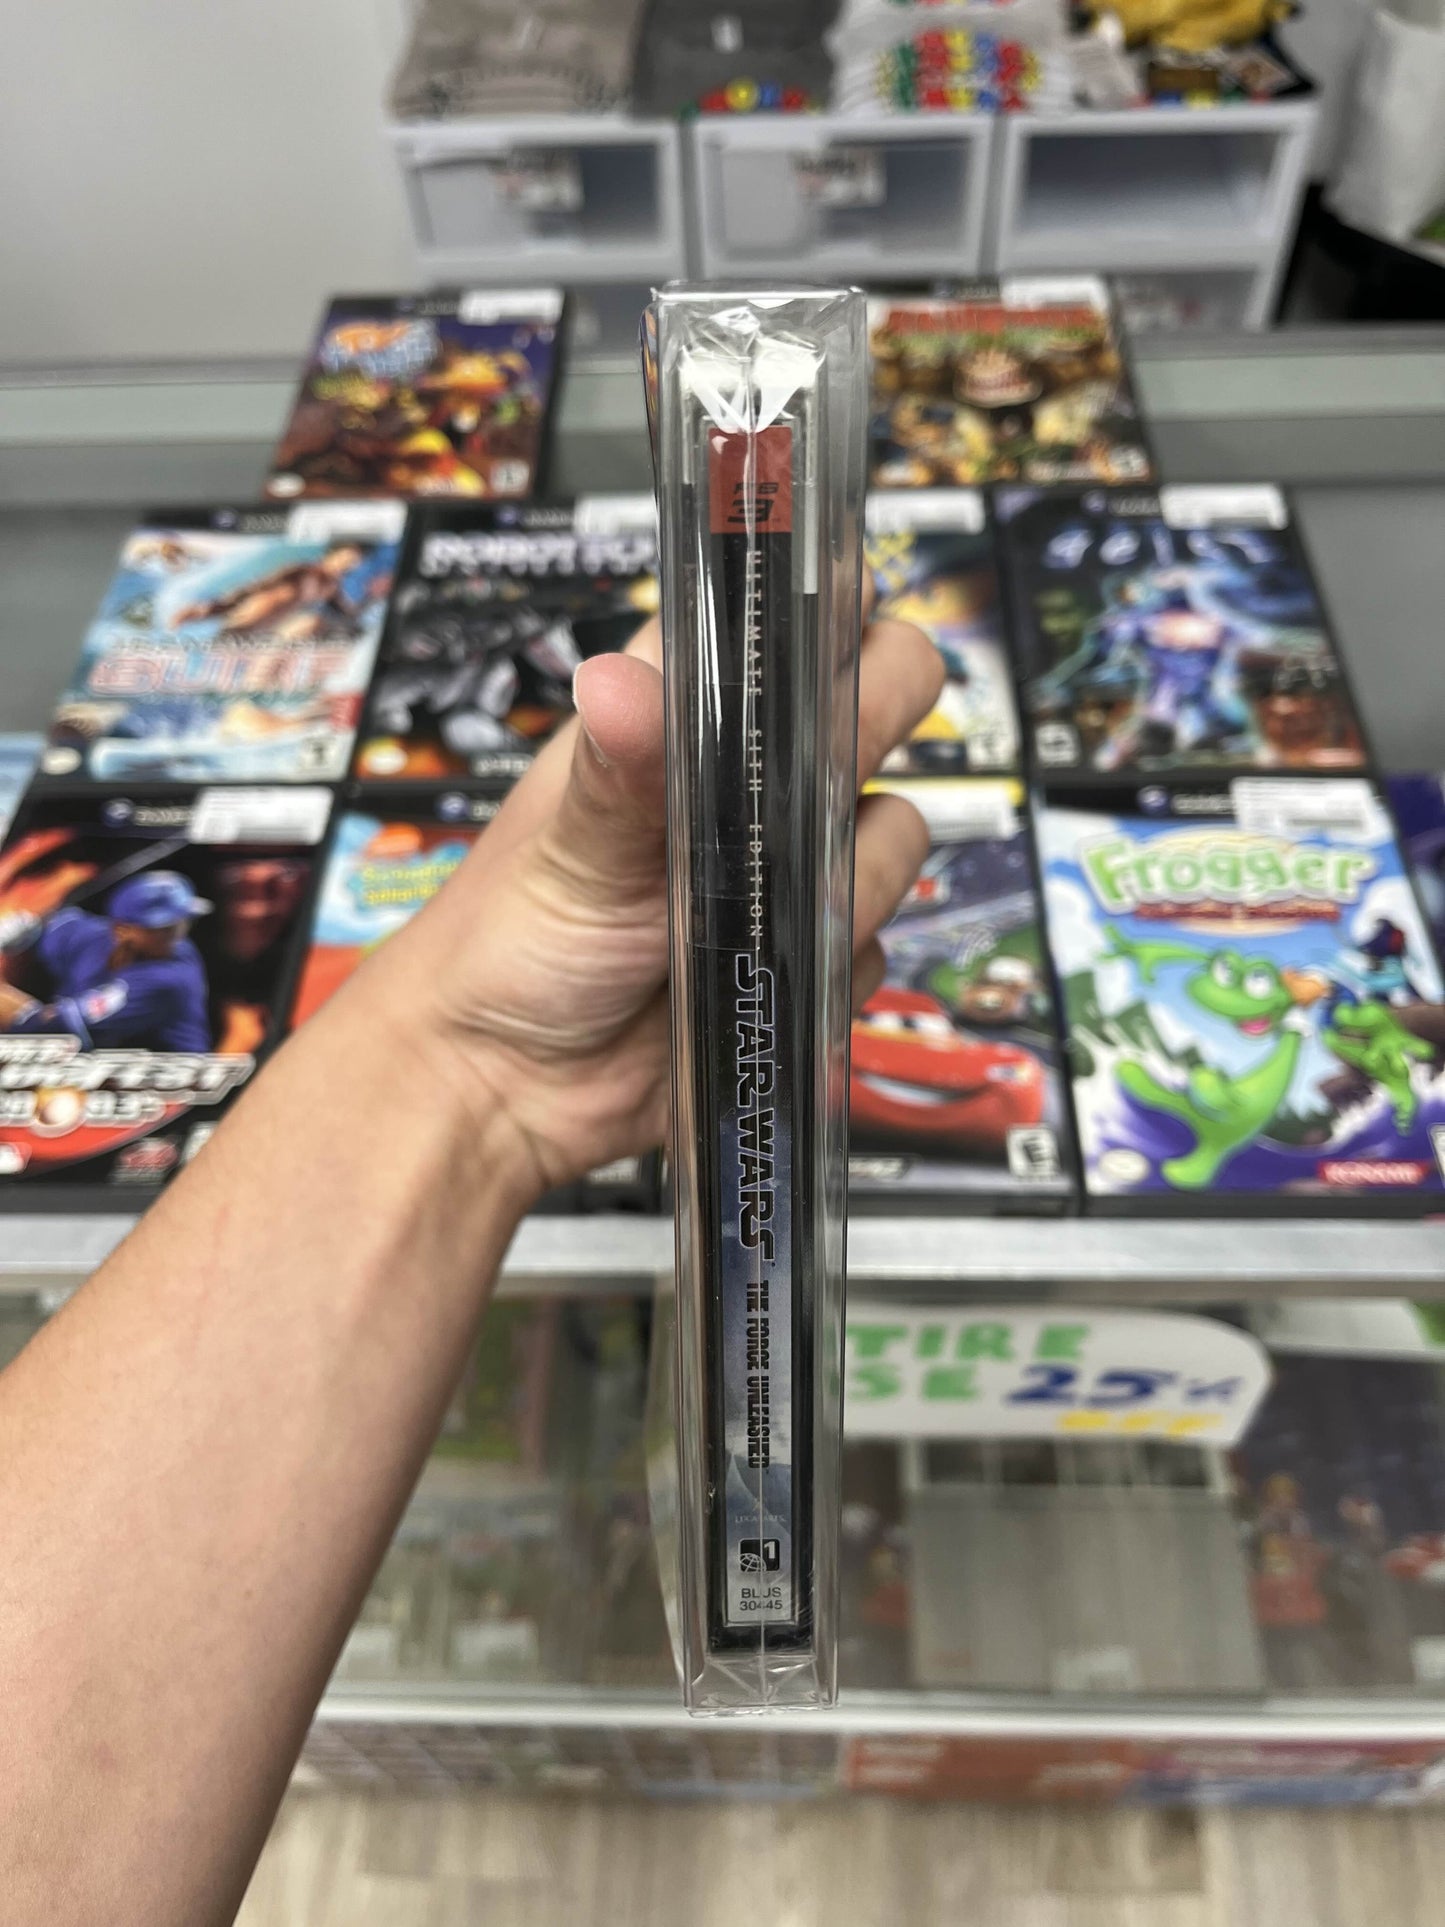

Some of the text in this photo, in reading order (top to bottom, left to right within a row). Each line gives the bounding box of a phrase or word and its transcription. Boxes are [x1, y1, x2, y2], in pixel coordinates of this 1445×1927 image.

[745, 550, 763, 937] ULTIMATE SITH EDITION
[1082, 838, 1374, 905] Frogger
[735, 953, 776, 1262] STAR WARS
[746, 1280, 771, 1469] THE FORCE UNLEASHED
